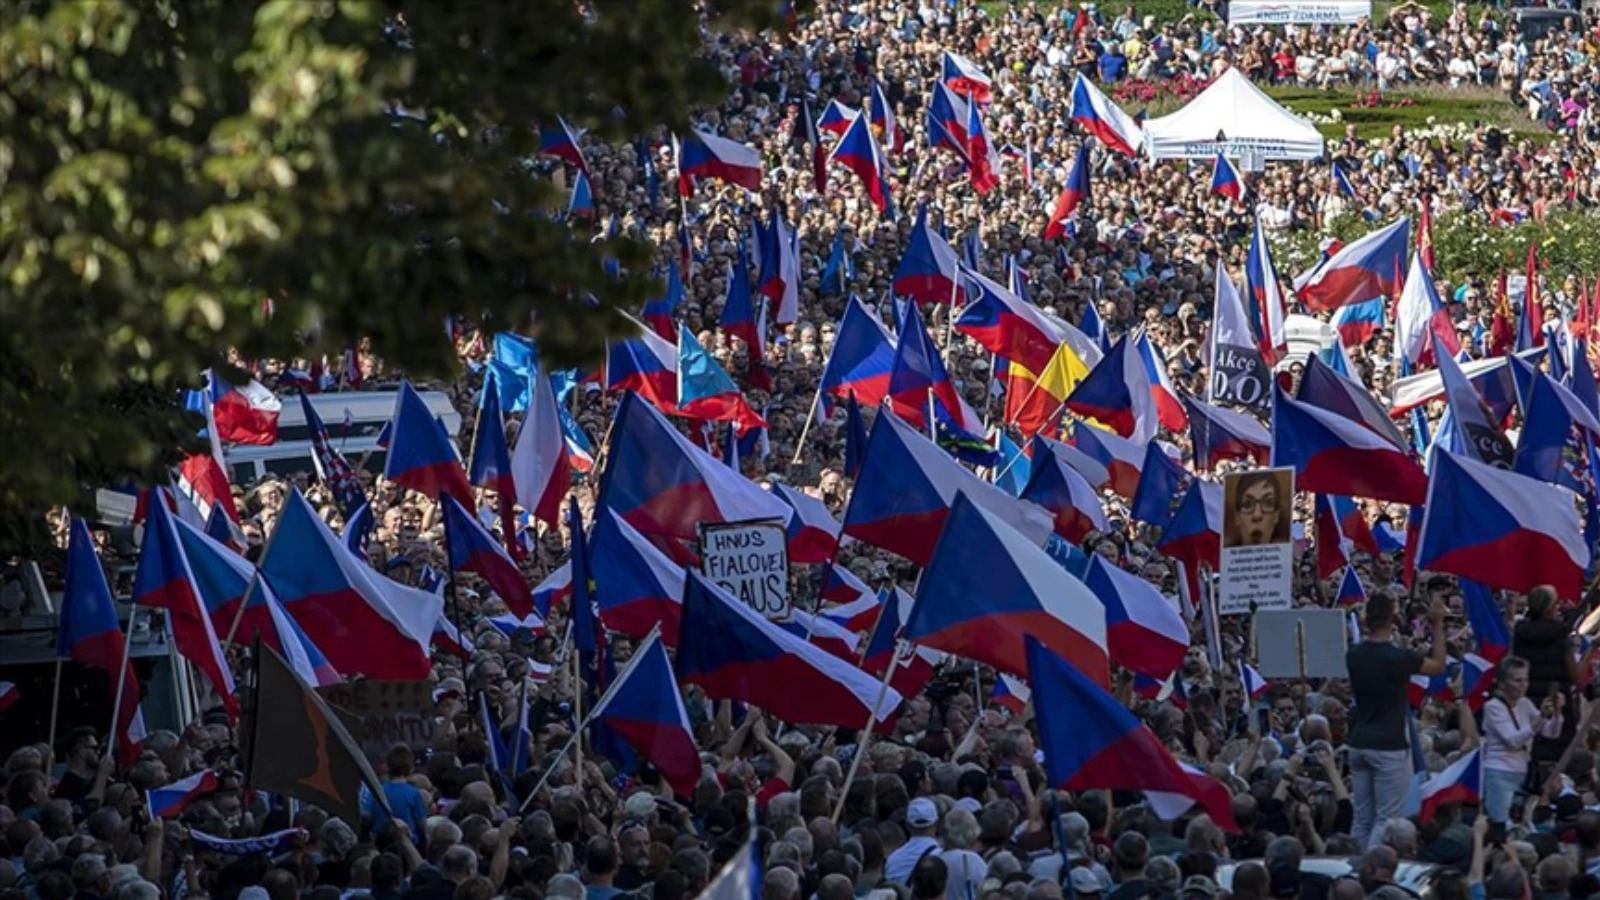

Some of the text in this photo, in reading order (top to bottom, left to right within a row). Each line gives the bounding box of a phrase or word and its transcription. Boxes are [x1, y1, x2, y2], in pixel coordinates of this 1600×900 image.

[1293, 11, 1340, 21] ZDARMA
[1216, 350, 1256, 372] Akce
[1214, 371, 1272, 407] D.O.
[714, 530, 766, 551] HNUS
